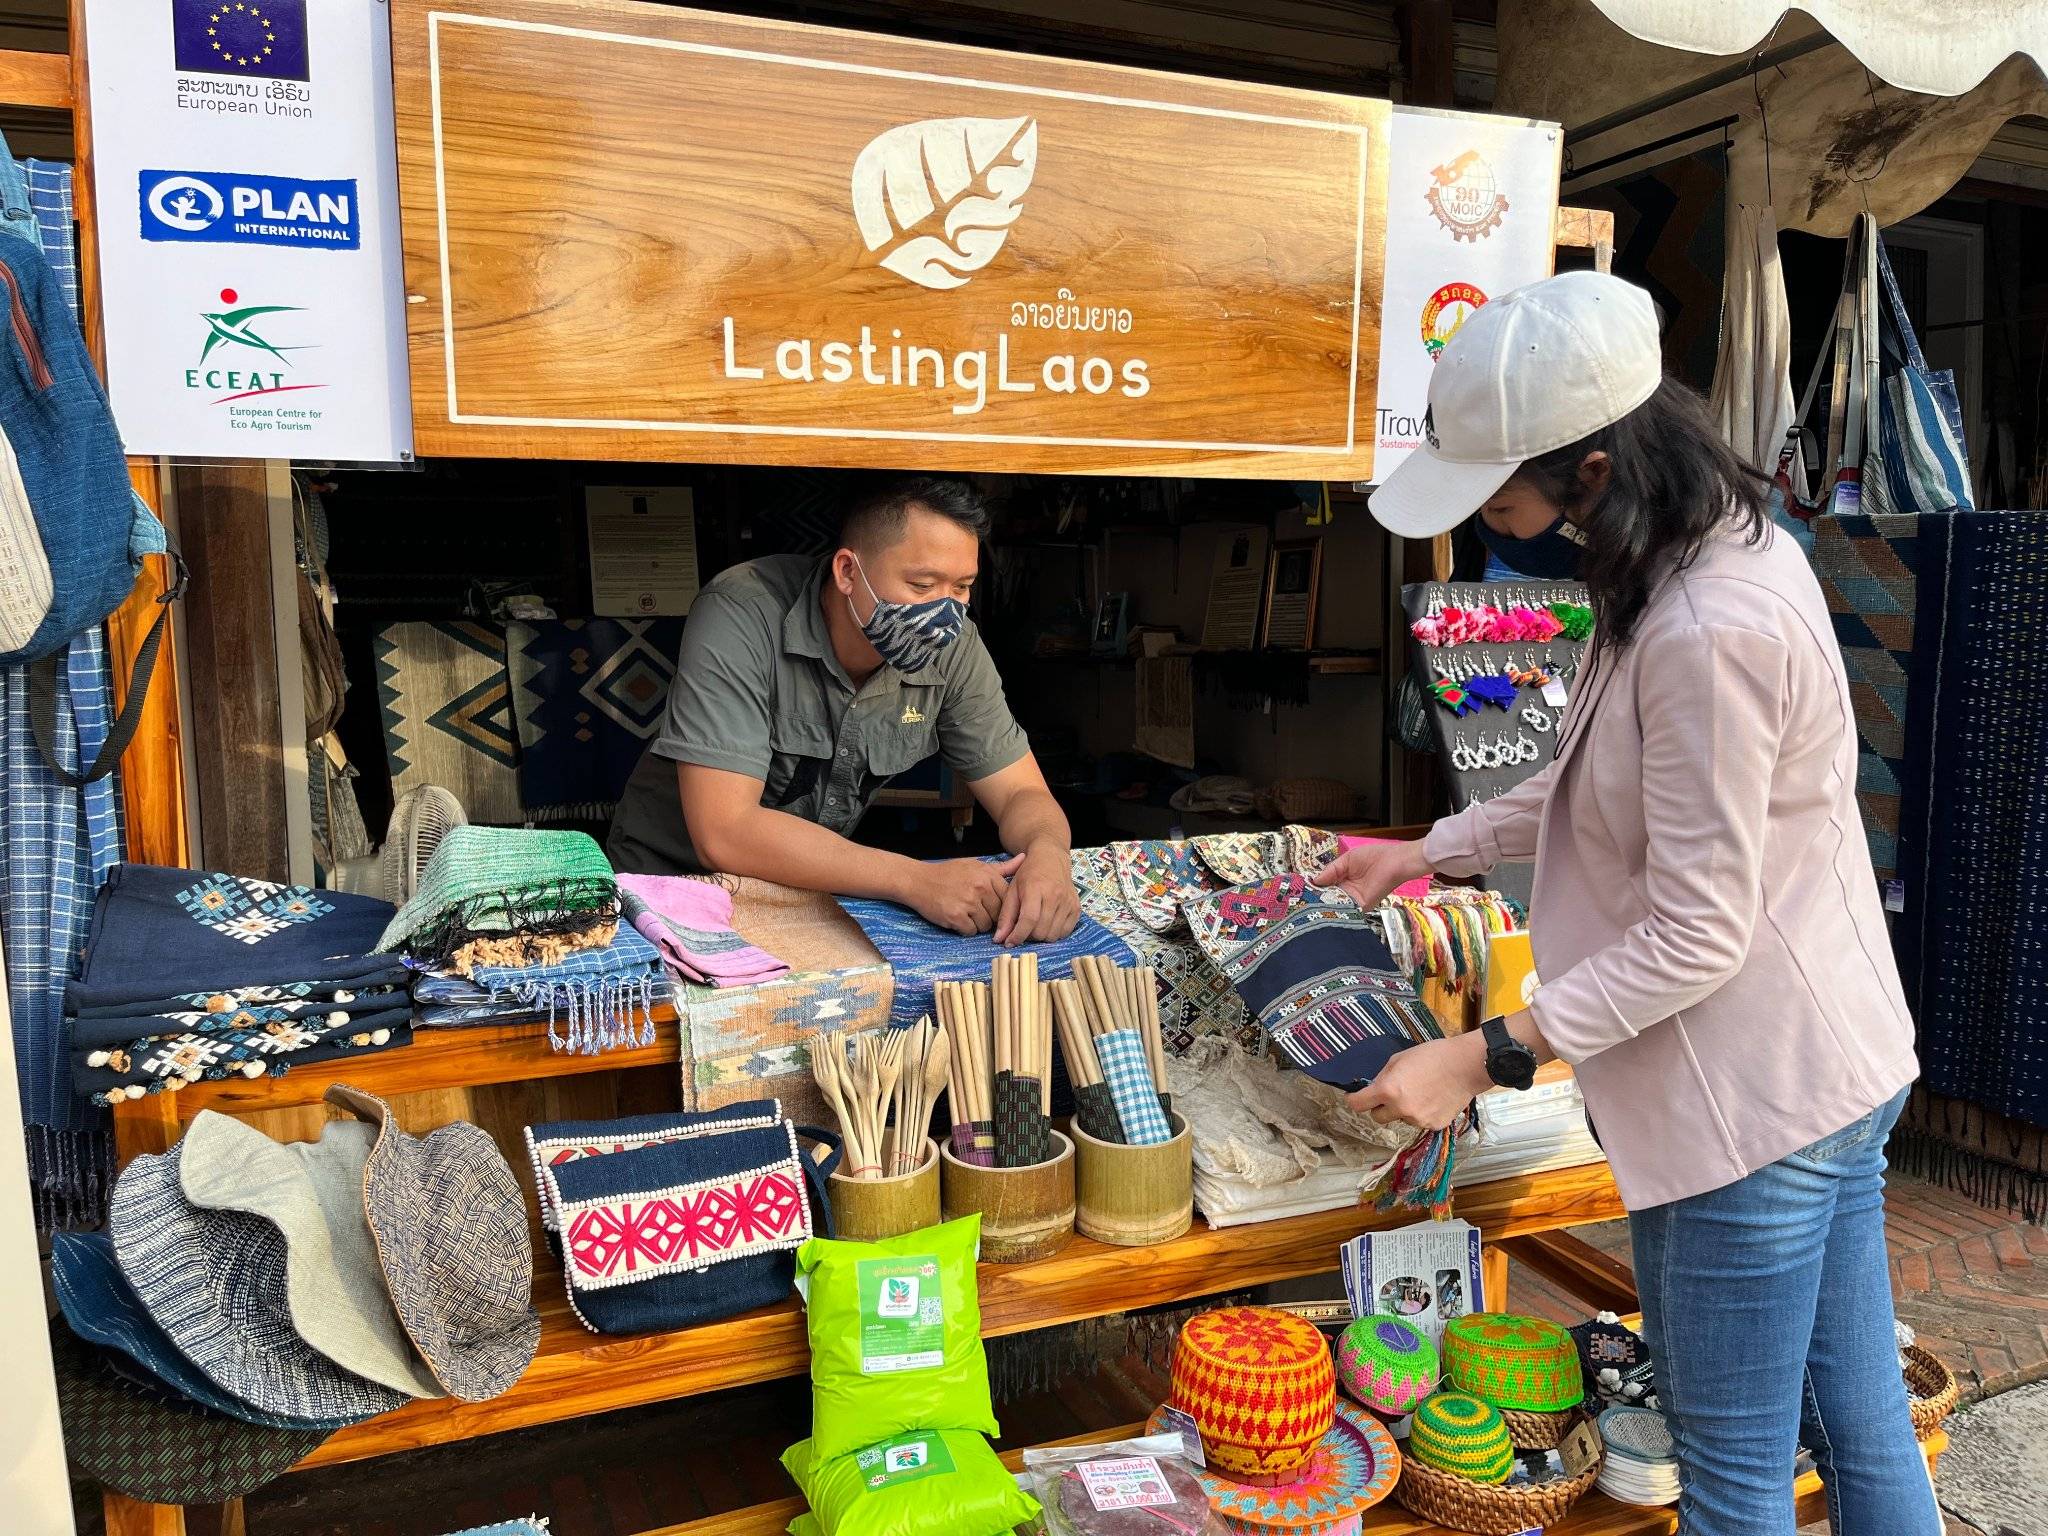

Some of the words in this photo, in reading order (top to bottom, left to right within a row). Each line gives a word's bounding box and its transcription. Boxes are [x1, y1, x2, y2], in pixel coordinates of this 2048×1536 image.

[177, 94, 258, 114] European
[265, 101, 312, 118] Union
[232, 186, 349, 225] PLAN
[1450, 204, 1483, 216] MOIC
[235, 223, 351, 241] INTERNATIONAL
[185, 369, 285, 391] ECEAT
[229, 407, 273, 418] European
[276, 408, 307, 418] Centre
[309, 409, 322, 418] for
[231, 420, 247, 429] Eco
[250, 420, 272, 431] Agro
[276, 421, 312, 431] Tourism
